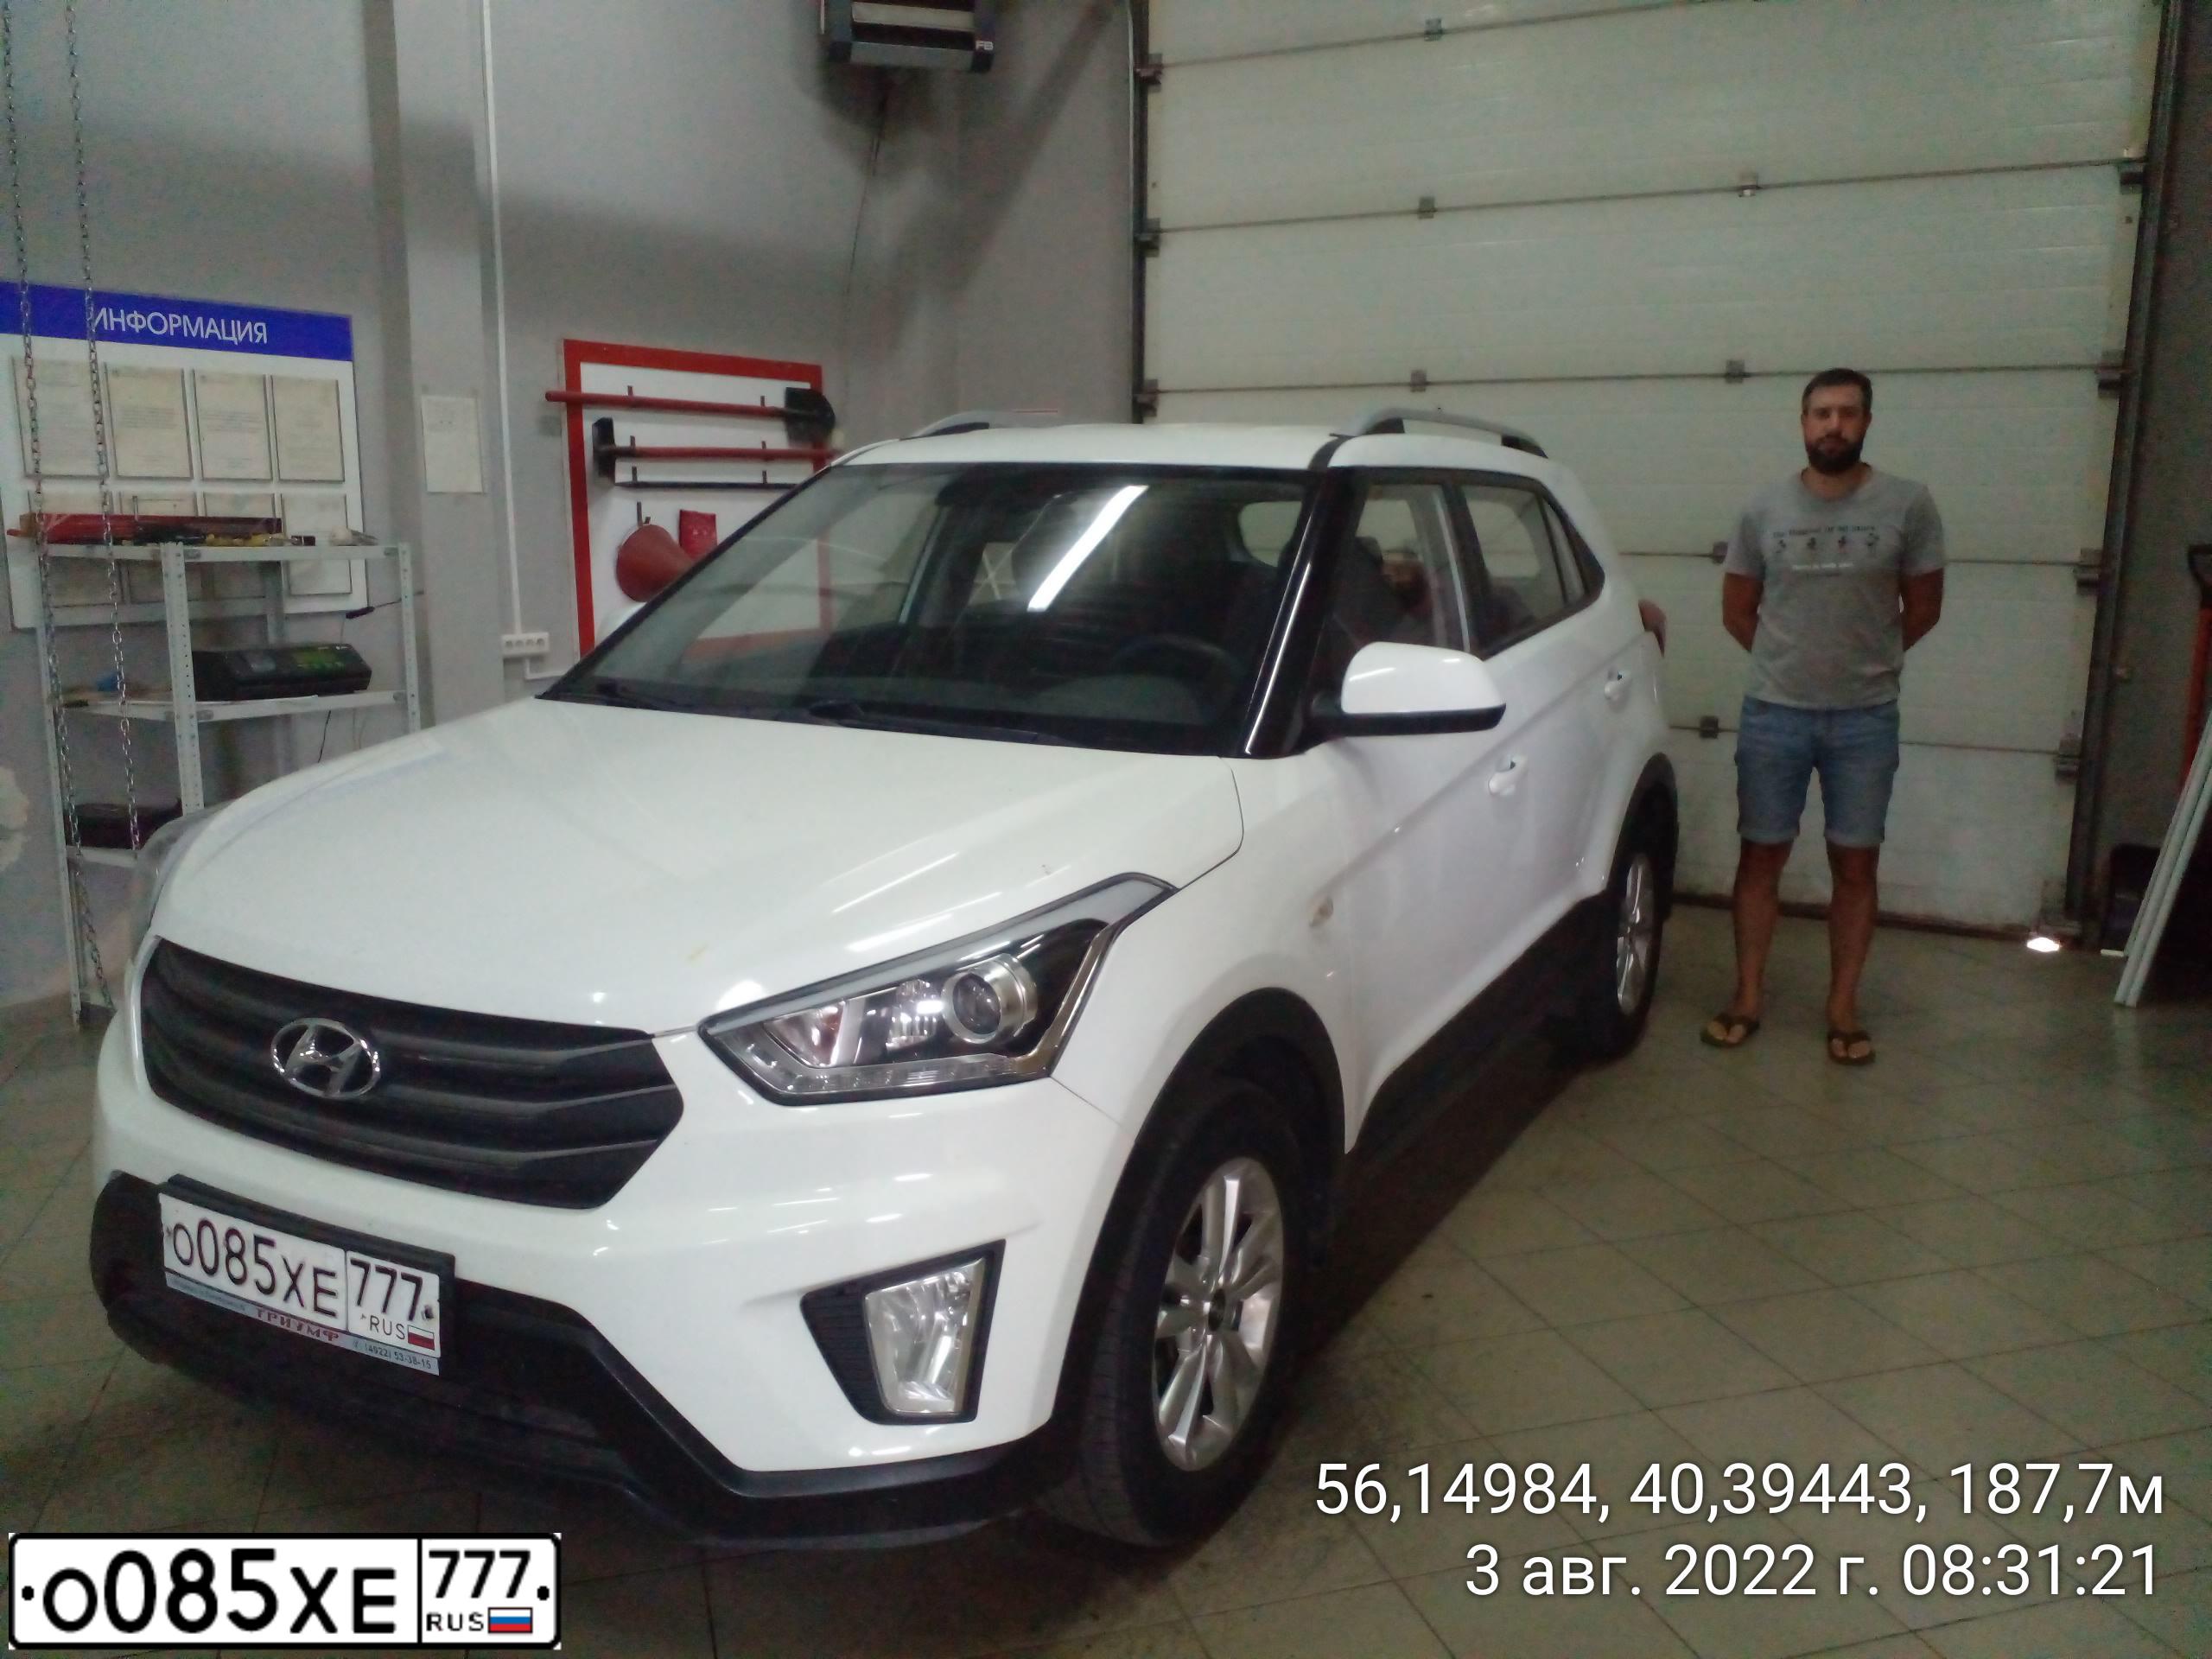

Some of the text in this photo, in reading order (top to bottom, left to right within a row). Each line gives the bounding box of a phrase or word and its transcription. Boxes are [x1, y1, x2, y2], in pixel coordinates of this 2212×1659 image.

[92, 307, 268, 346] ИНФОРМАЦИЯ
[350, 1258, 423, 1322] 777
[256, 1307, 340, 1342] ТРИУМФ
[369, 1315, 406, 1340] RUS
